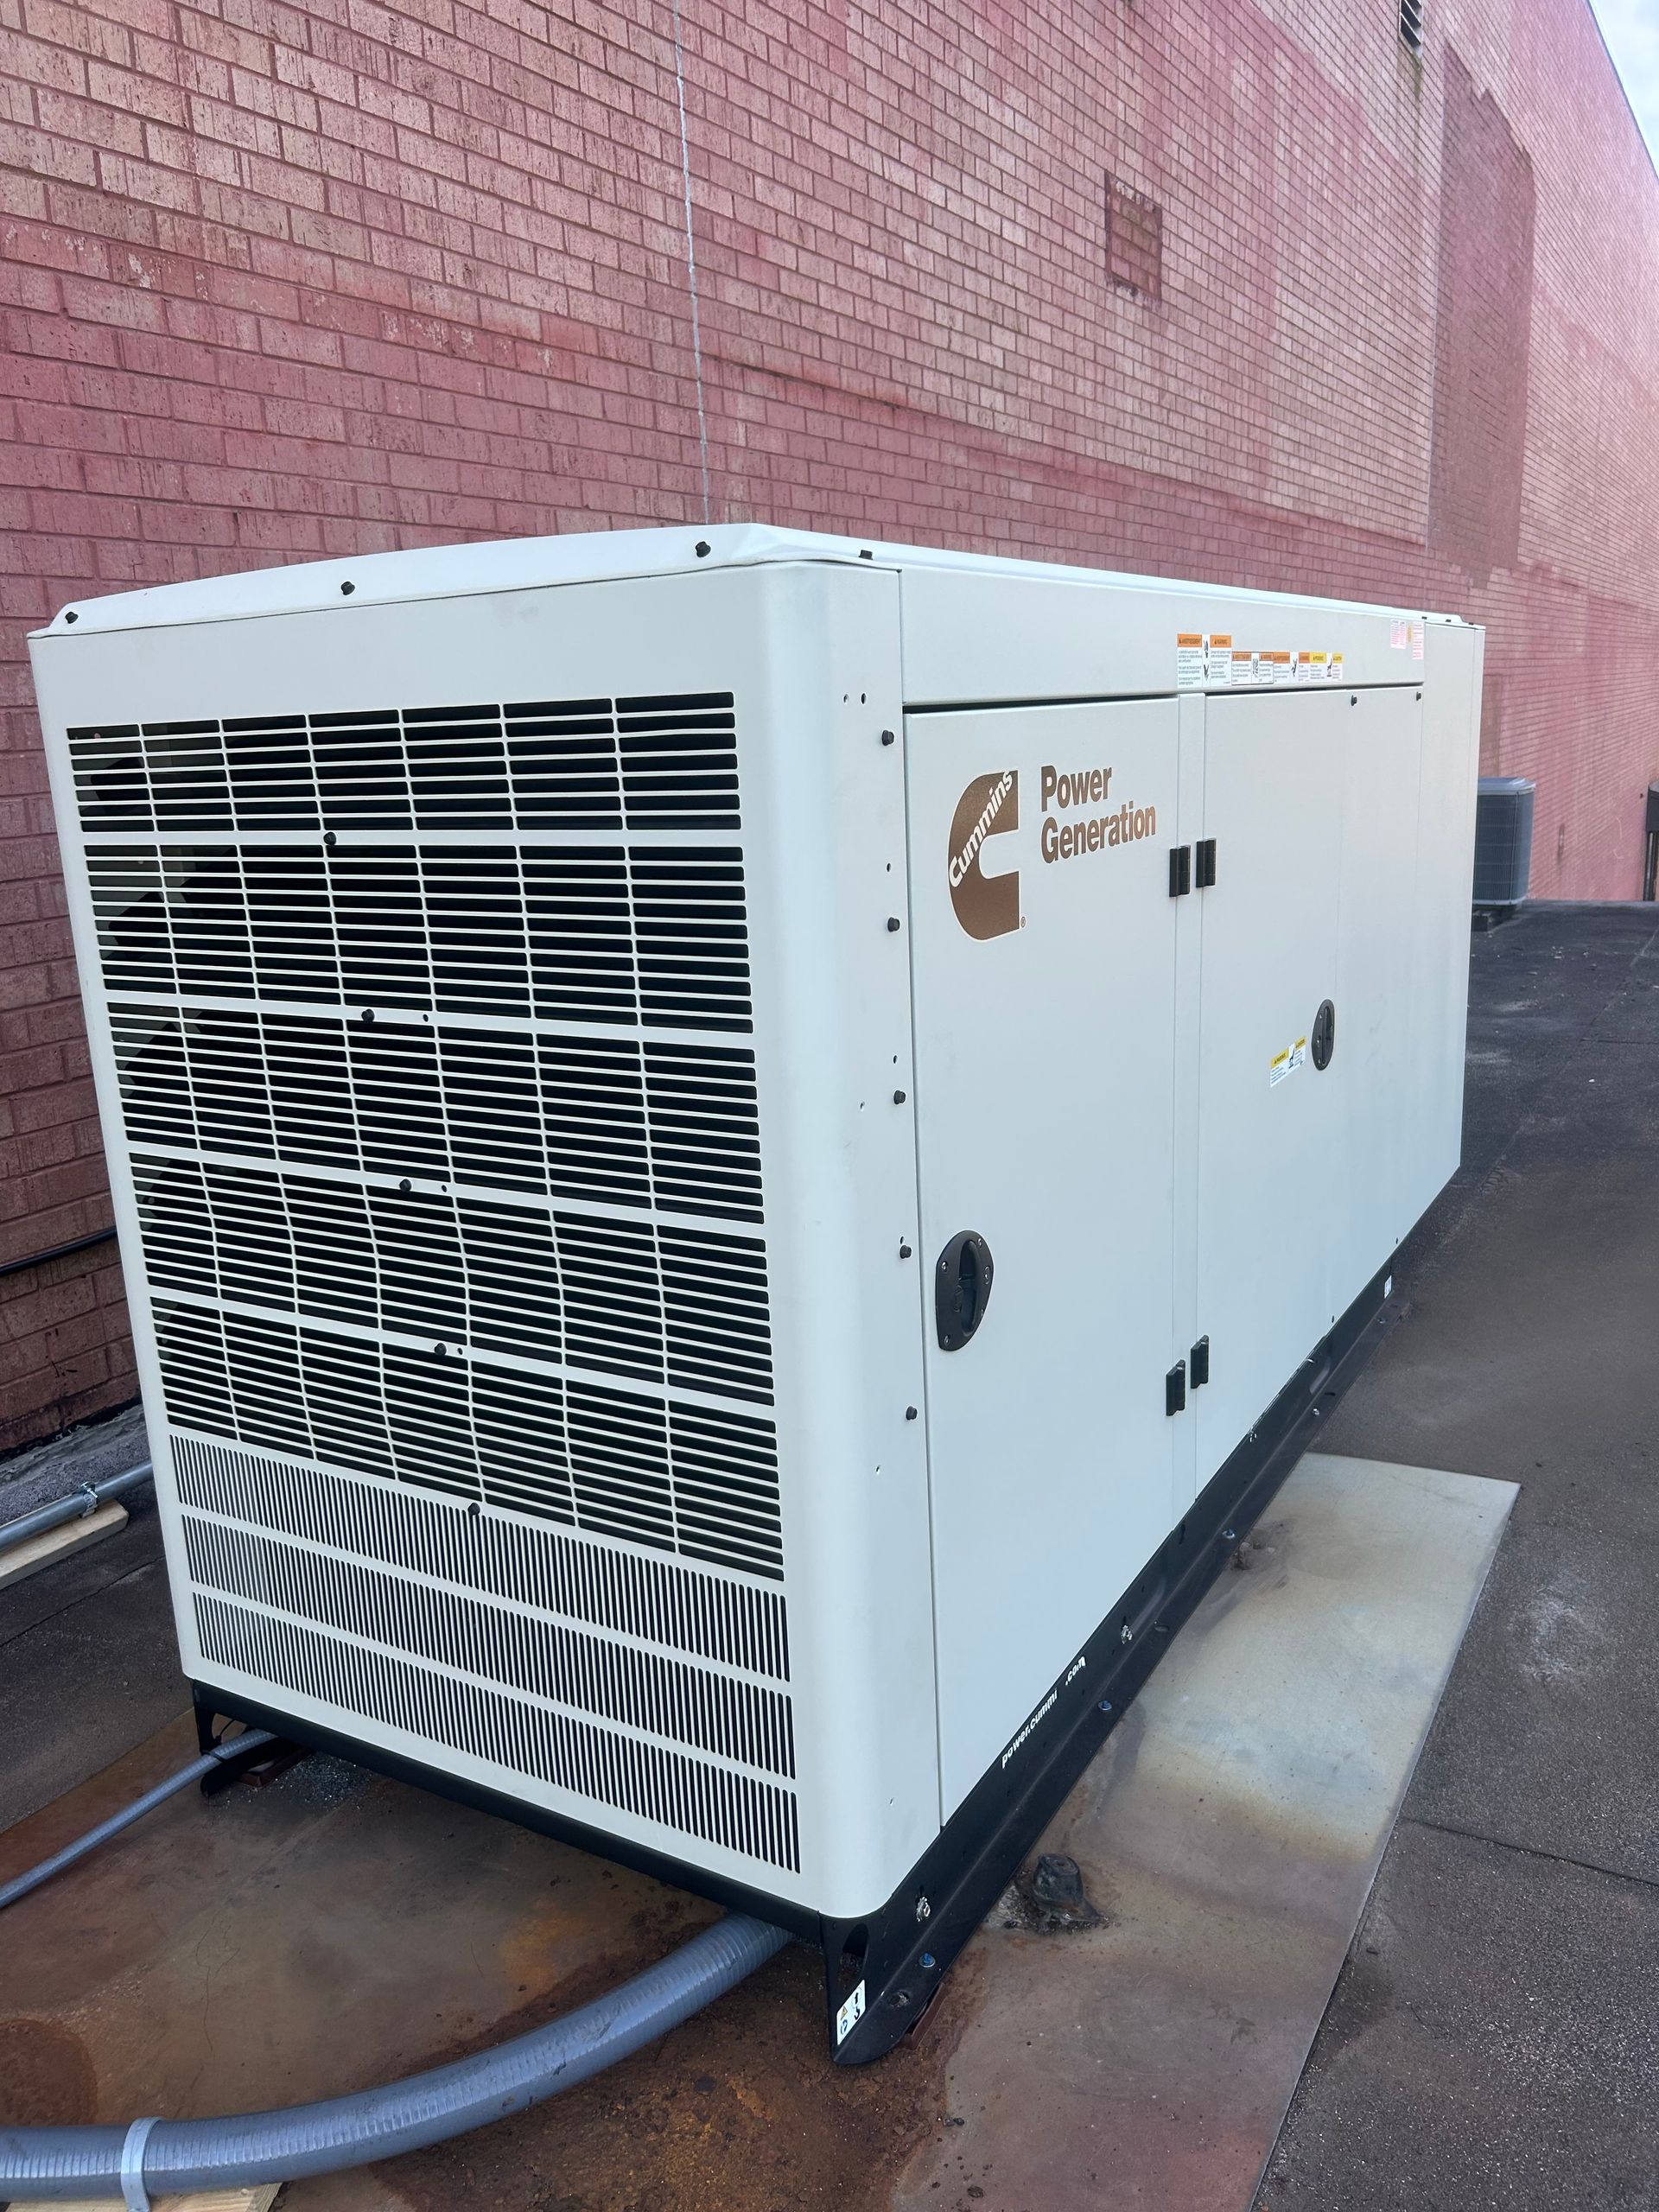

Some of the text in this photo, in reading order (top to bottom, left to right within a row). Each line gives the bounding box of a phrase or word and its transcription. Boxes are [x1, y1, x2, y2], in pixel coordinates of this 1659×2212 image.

[1041, 765, 1112, 812] Power
[949, 771, 1013, 887] Cummins
[1041, 800, 1156, 864] Generation
